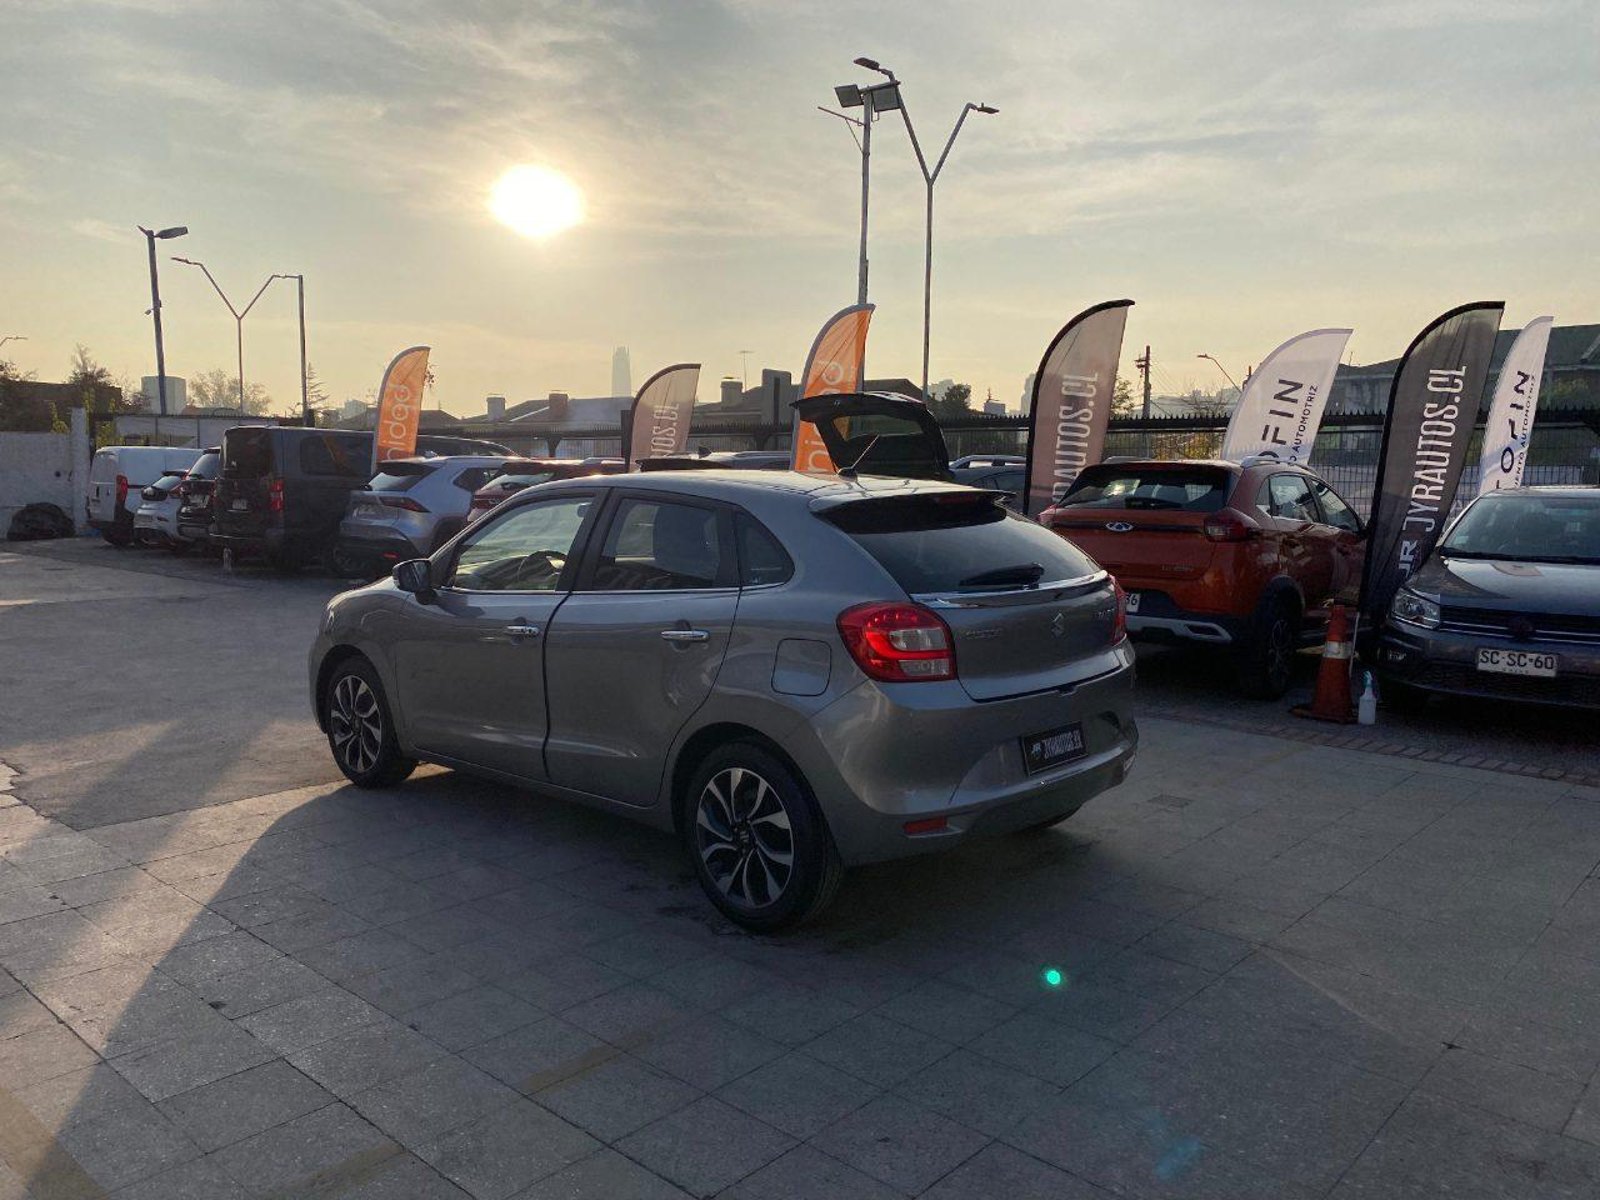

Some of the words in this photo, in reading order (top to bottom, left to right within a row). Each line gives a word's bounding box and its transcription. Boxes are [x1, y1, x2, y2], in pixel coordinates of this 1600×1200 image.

[1258, 379, 1304, 458] FIN
[1292, 385, 1318, 453] AUTOMOTRIZ
[1402, 365, 1467, 532] JYRAUTOS.CL
